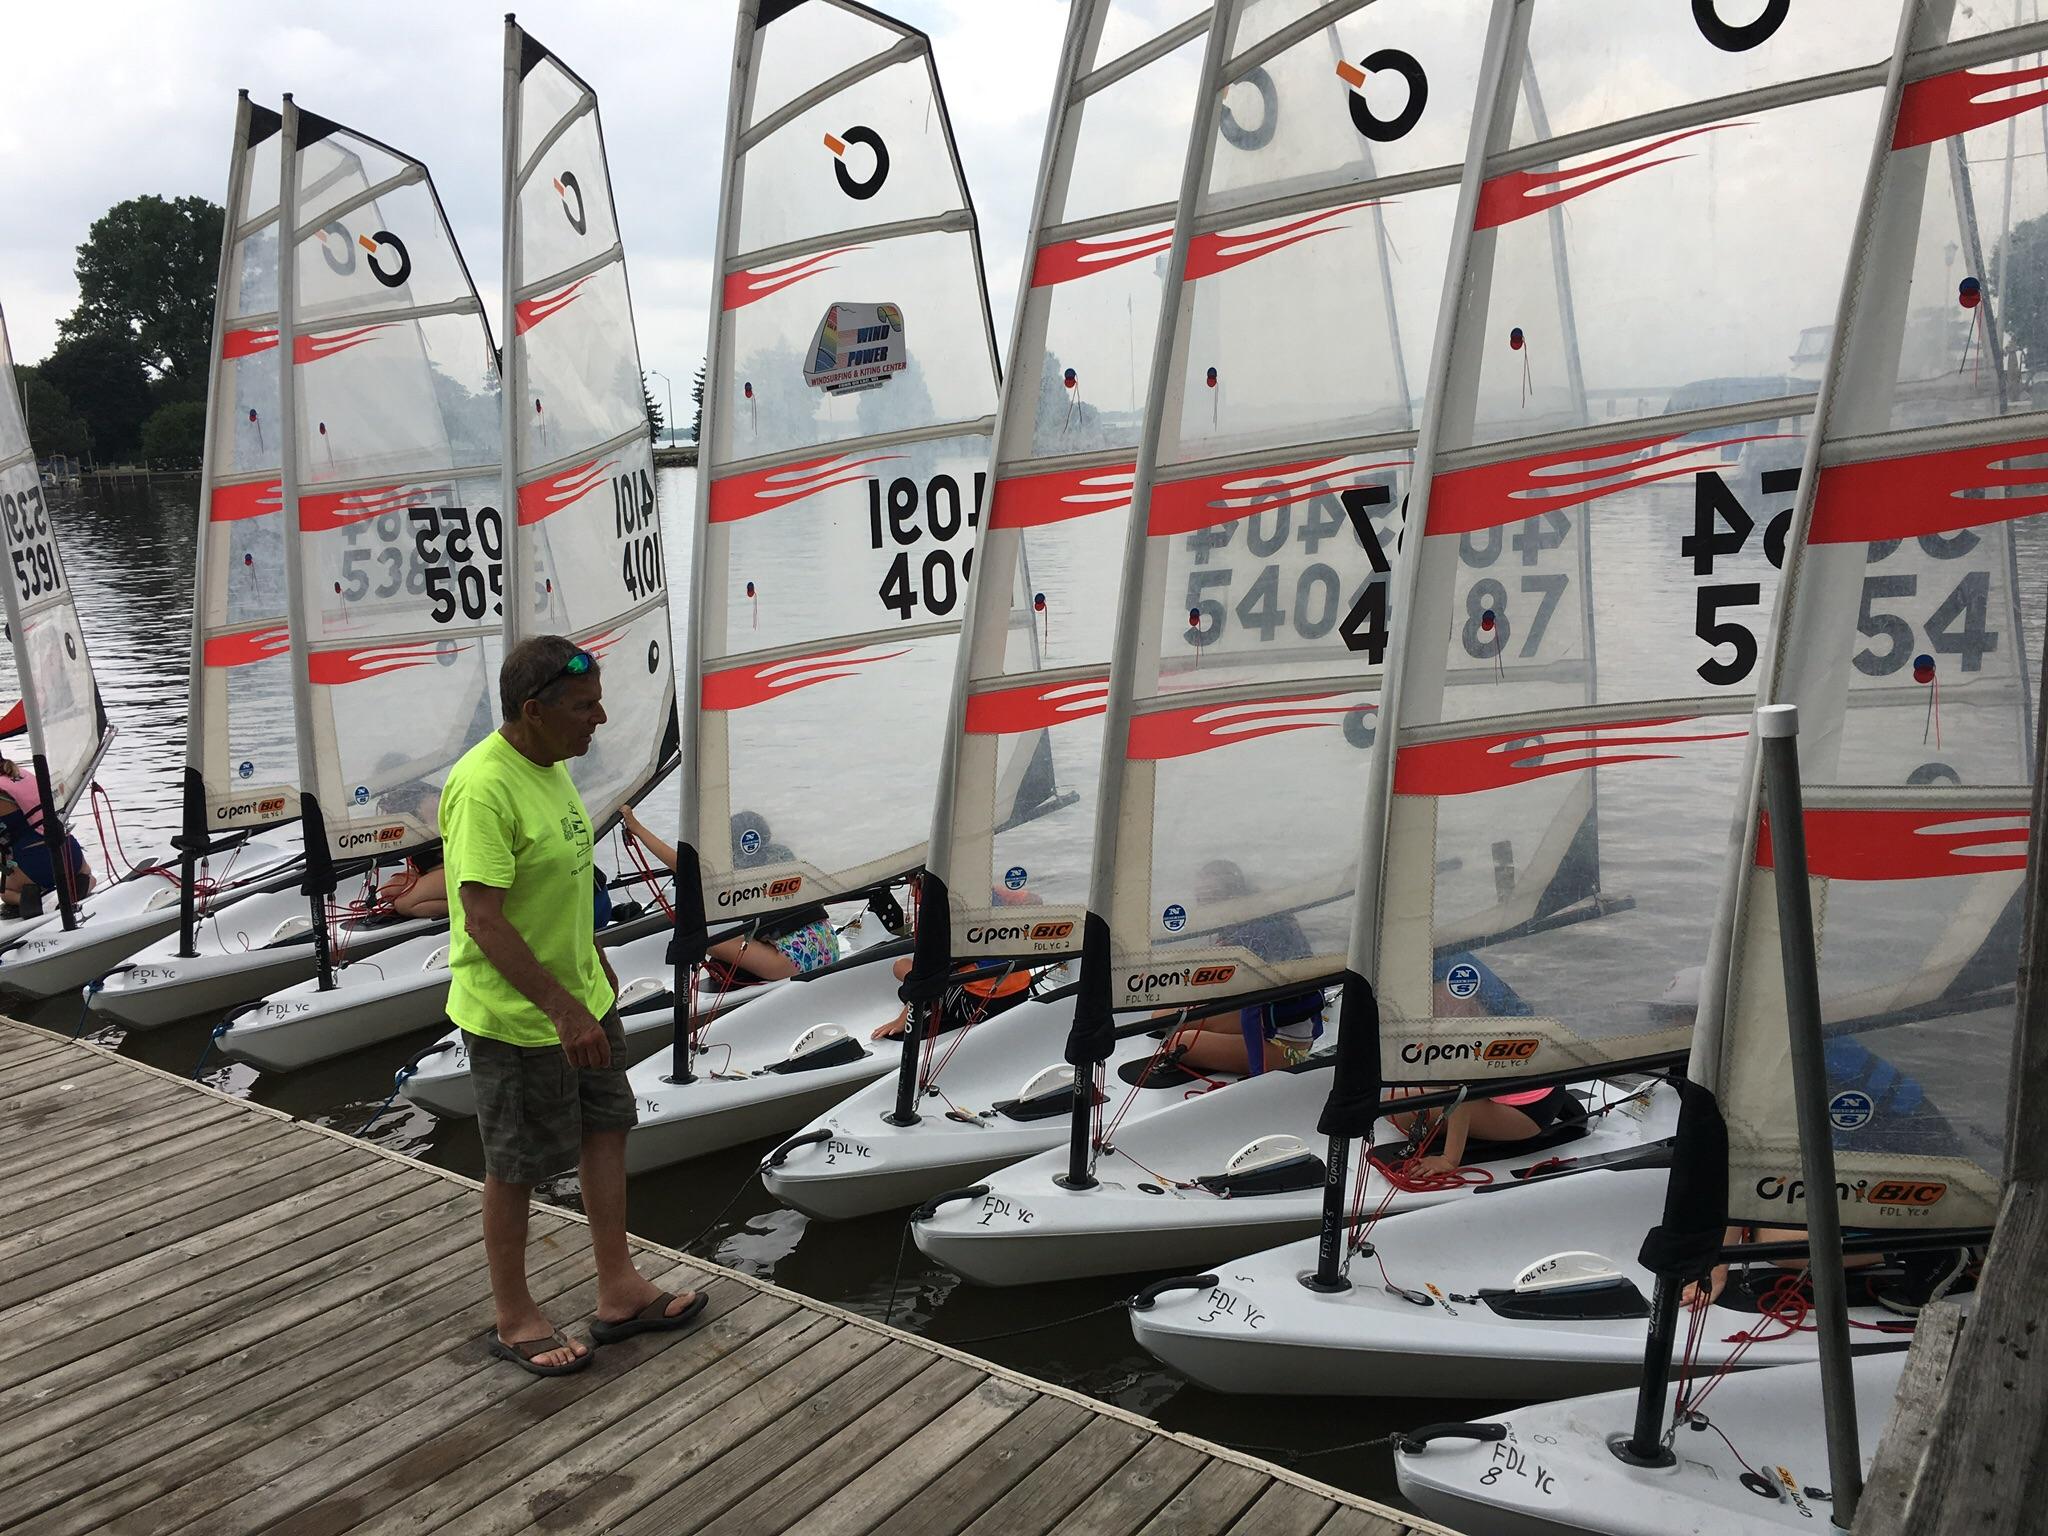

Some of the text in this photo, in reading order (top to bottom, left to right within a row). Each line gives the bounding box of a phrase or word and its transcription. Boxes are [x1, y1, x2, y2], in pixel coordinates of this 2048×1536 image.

[857, 325, 890, 344] WIND
[847, 346, 889, 368] POWER
[811, 371, 852, 386] WINDSURFING
[860, 366, 881, 377] KITING
[882, 361, 907, 374] CENTER
[12, 541, 61, 601] 5391
[623, 532, 662, 601] 4101
[879, 549, 974, 620] 40
[217, 804, 251, 820] Open
[338, 833, 371, 849] Open
[718, 886, 761, 906] Open
[966, 926, 1020, 944] Open
[28, 941, 46, 950] FDL
[1034, 942, 1047, 951] FDL
[132, 969, 158, 980] FDL
[1127, 971, 1180, 993] Open
[1125, 994, 1142, 1004] FDL
[266, 1005, 291, 1016] FDL
[1401, 1042, 1469, 1065] Open
[456, 1059, 465, 1069] 6
[1486, 1060, 1507, 1069] FDL
[827, 1141, 872, 1158] FDL YC
[825, 1153, 837, 1165] 2
[1232, 1155, 1245, 1168] FDL
[1328, 1156, 1340, 1185] Open
[1756, 1176, 1849, 1204] Opn
[977, 1212, 994, 1226] 1
[982, 1196, 1034, 1224] FDL YC
[1879, 1206, 1903, 1217] FDL
[1521, 1272, 1536, 1285] FDL
[1536, 1266, 1548, 1275] YC
[1197, 1310, 1222, 1323] 5
[1207, 1288, 1266, 1329] FDL YC
[1479, 1466, 1503, 1486] 8
[1492, 1442, 1555, 1495] FDL YC
